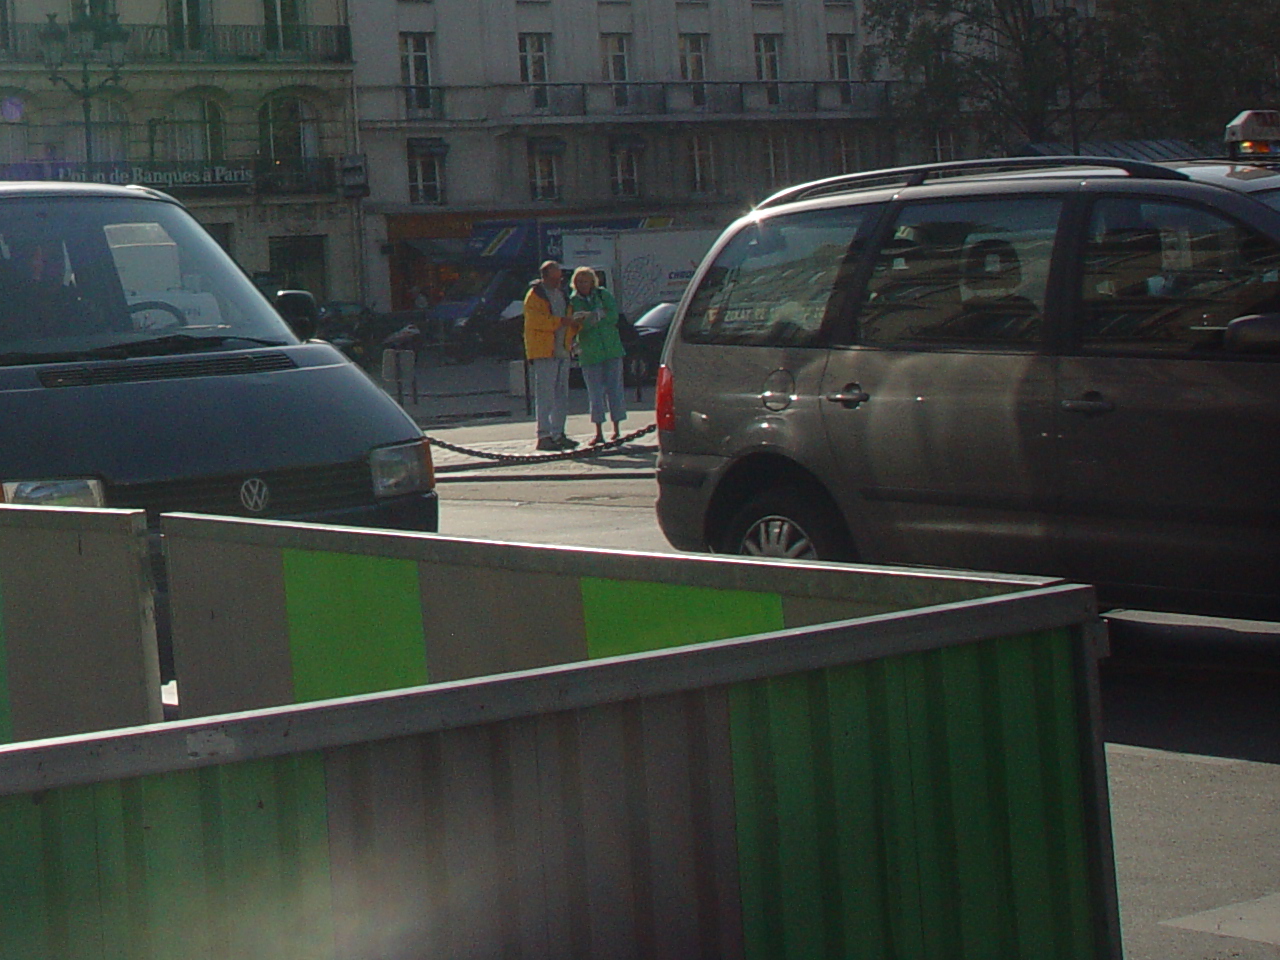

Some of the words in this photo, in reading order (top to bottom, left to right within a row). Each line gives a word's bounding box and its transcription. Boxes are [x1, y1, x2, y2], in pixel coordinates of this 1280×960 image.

[110, 168, 130, 183] de
[132, 167, 201, 187] Banques
[214, 165, 253, 182] Paris
